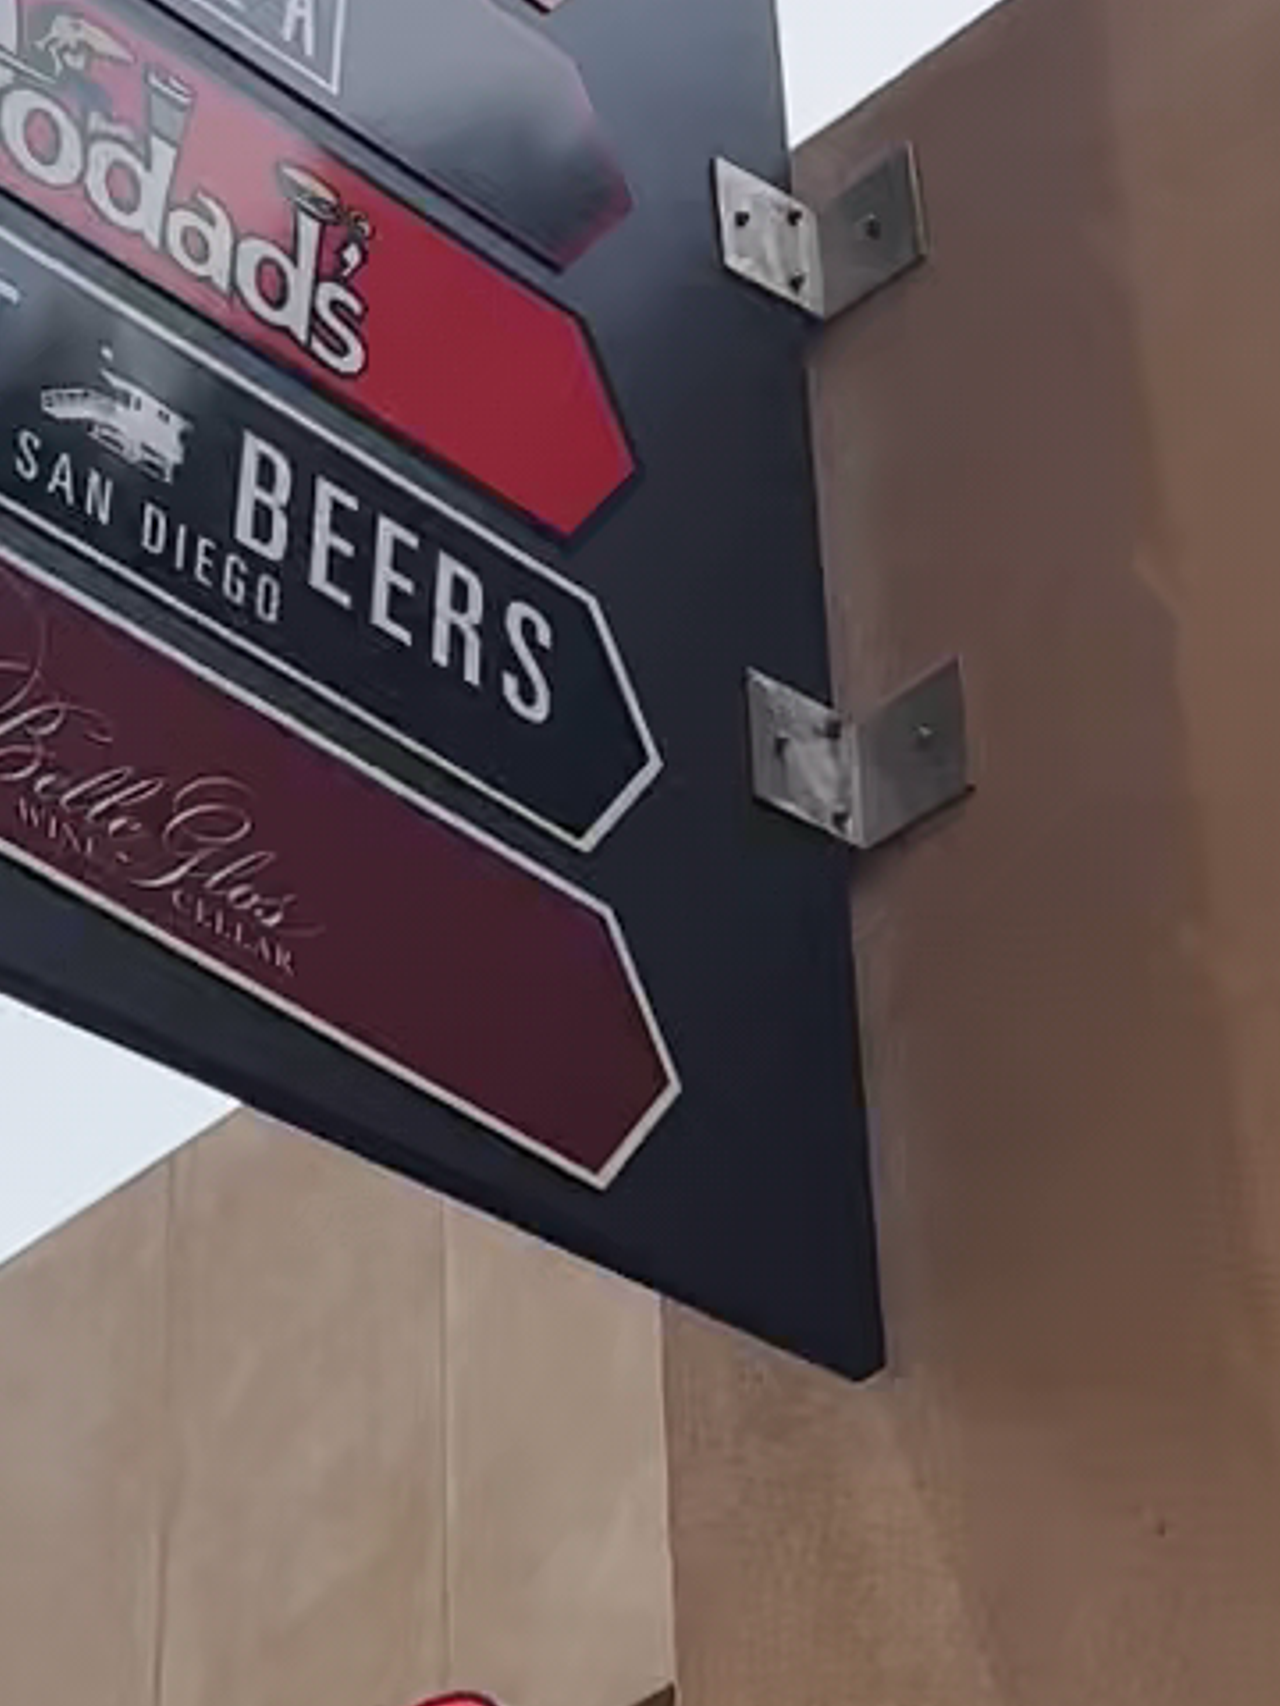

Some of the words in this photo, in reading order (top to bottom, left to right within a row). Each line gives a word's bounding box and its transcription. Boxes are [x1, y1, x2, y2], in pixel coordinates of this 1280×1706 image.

[14, 430, 114, 526] SAN
[141, 502, 281, 625] DIEGO
[231, 429, 551, 725] BEERS
[128, 775, 312, 931] Glos
